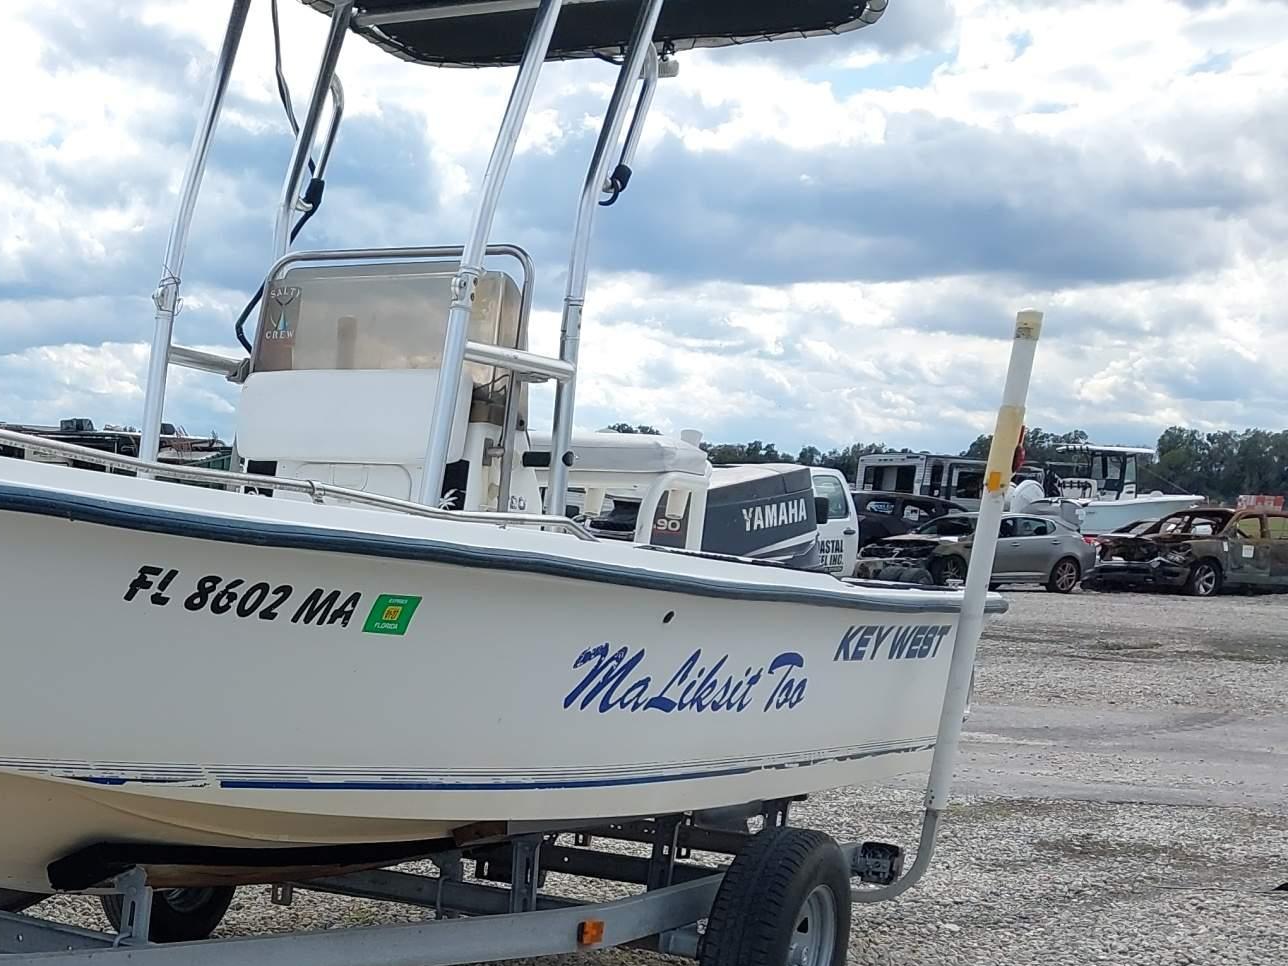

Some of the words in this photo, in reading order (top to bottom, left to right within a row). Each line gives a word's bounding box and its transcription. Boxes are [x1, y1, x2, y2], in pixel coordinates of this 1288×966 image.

[265, 330, 295, 340] CREW
[742, 498, 807, 532] YAMAHA
[124, 565, 179, 606] FL
[184, 575, 293, 621] 8602
[291, 588, 363, 628] MA
[374, 622, 399, 630] FLORIDA
[833, 625, 895, 661] KEY
[887, 624, 952, 660] WEST
